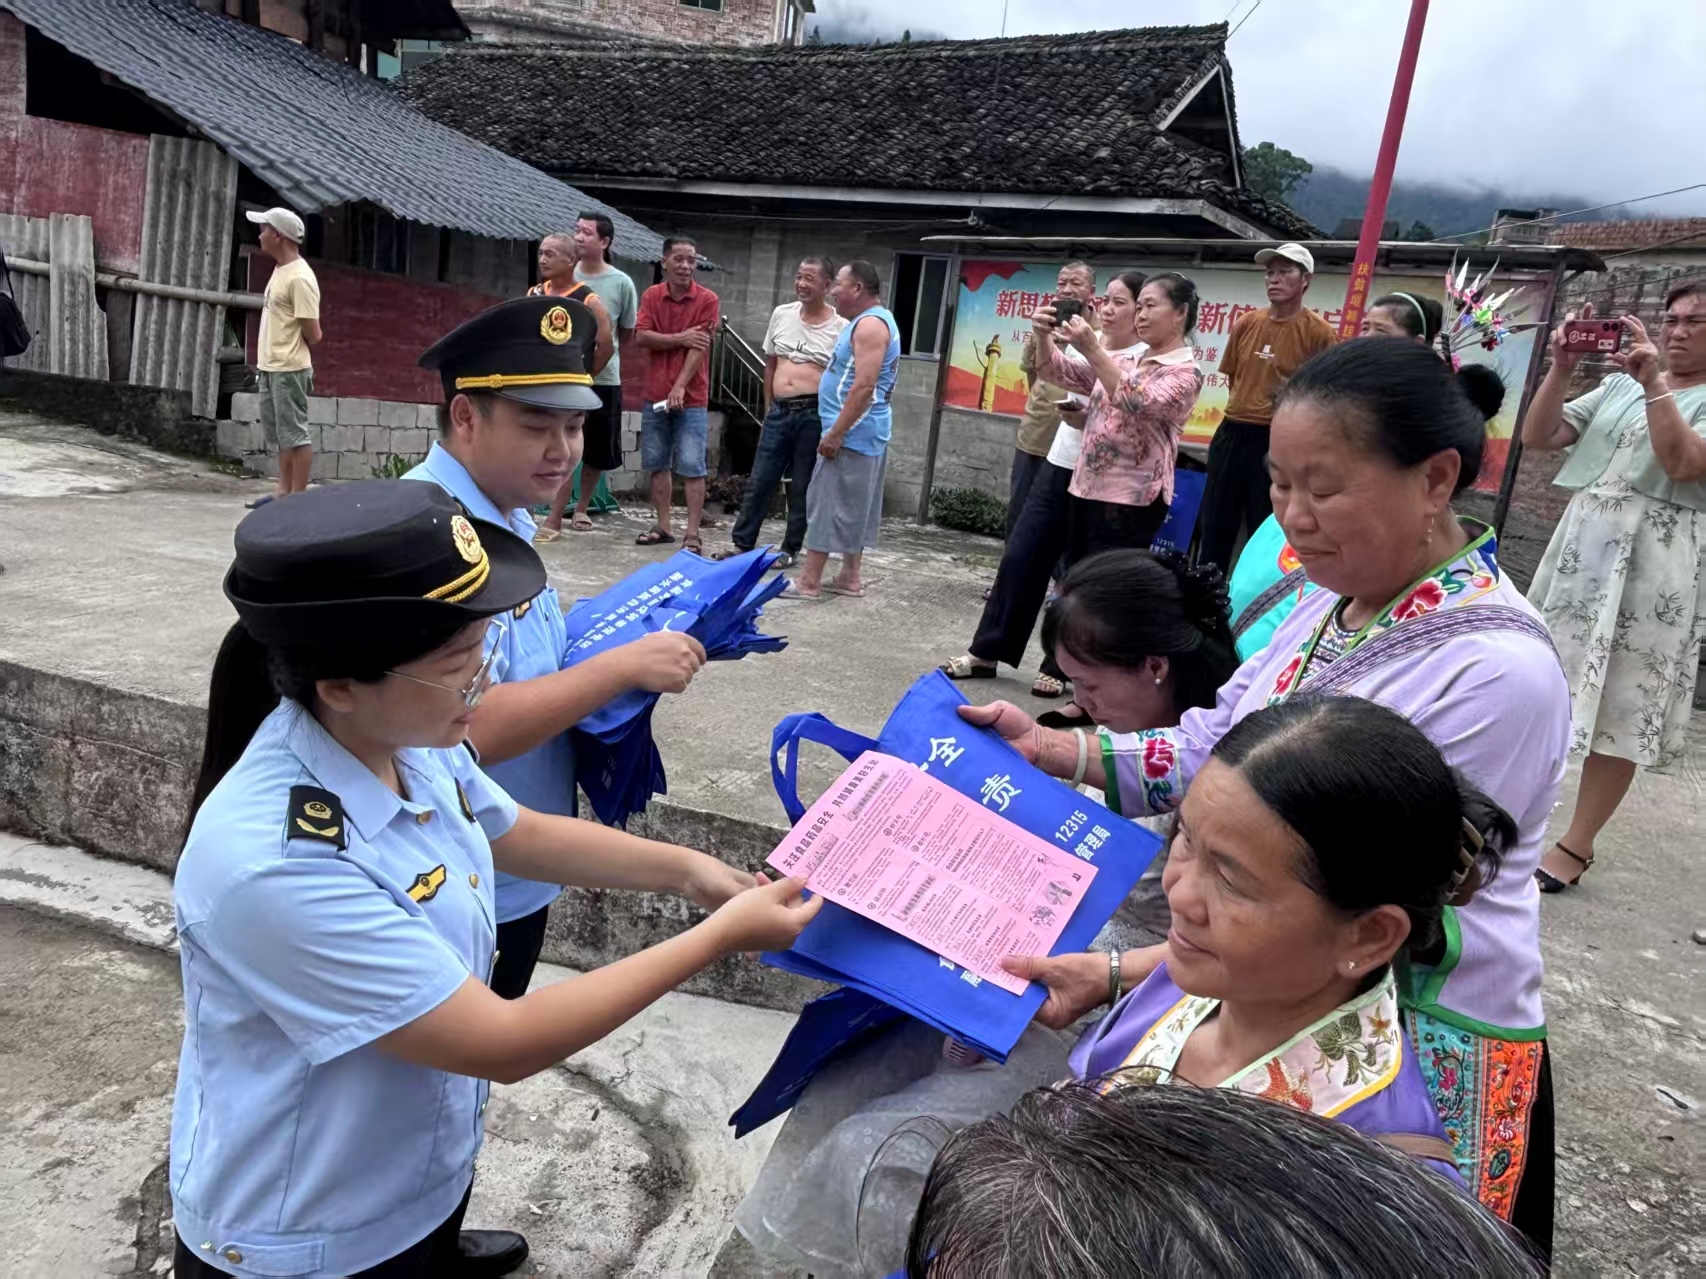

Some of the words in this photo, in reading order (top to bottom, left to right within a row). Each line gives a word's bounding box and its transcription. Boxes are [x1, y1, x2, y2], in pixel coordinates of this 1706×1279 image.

[1202, 373, 1229, 388] 伟大
[921, 736, 965, 768] 全
[981, 773, 1022, 812] 责
[1055, 810, 1089, 842] 12315
[1074, 825, 1112, 861] 管理局
